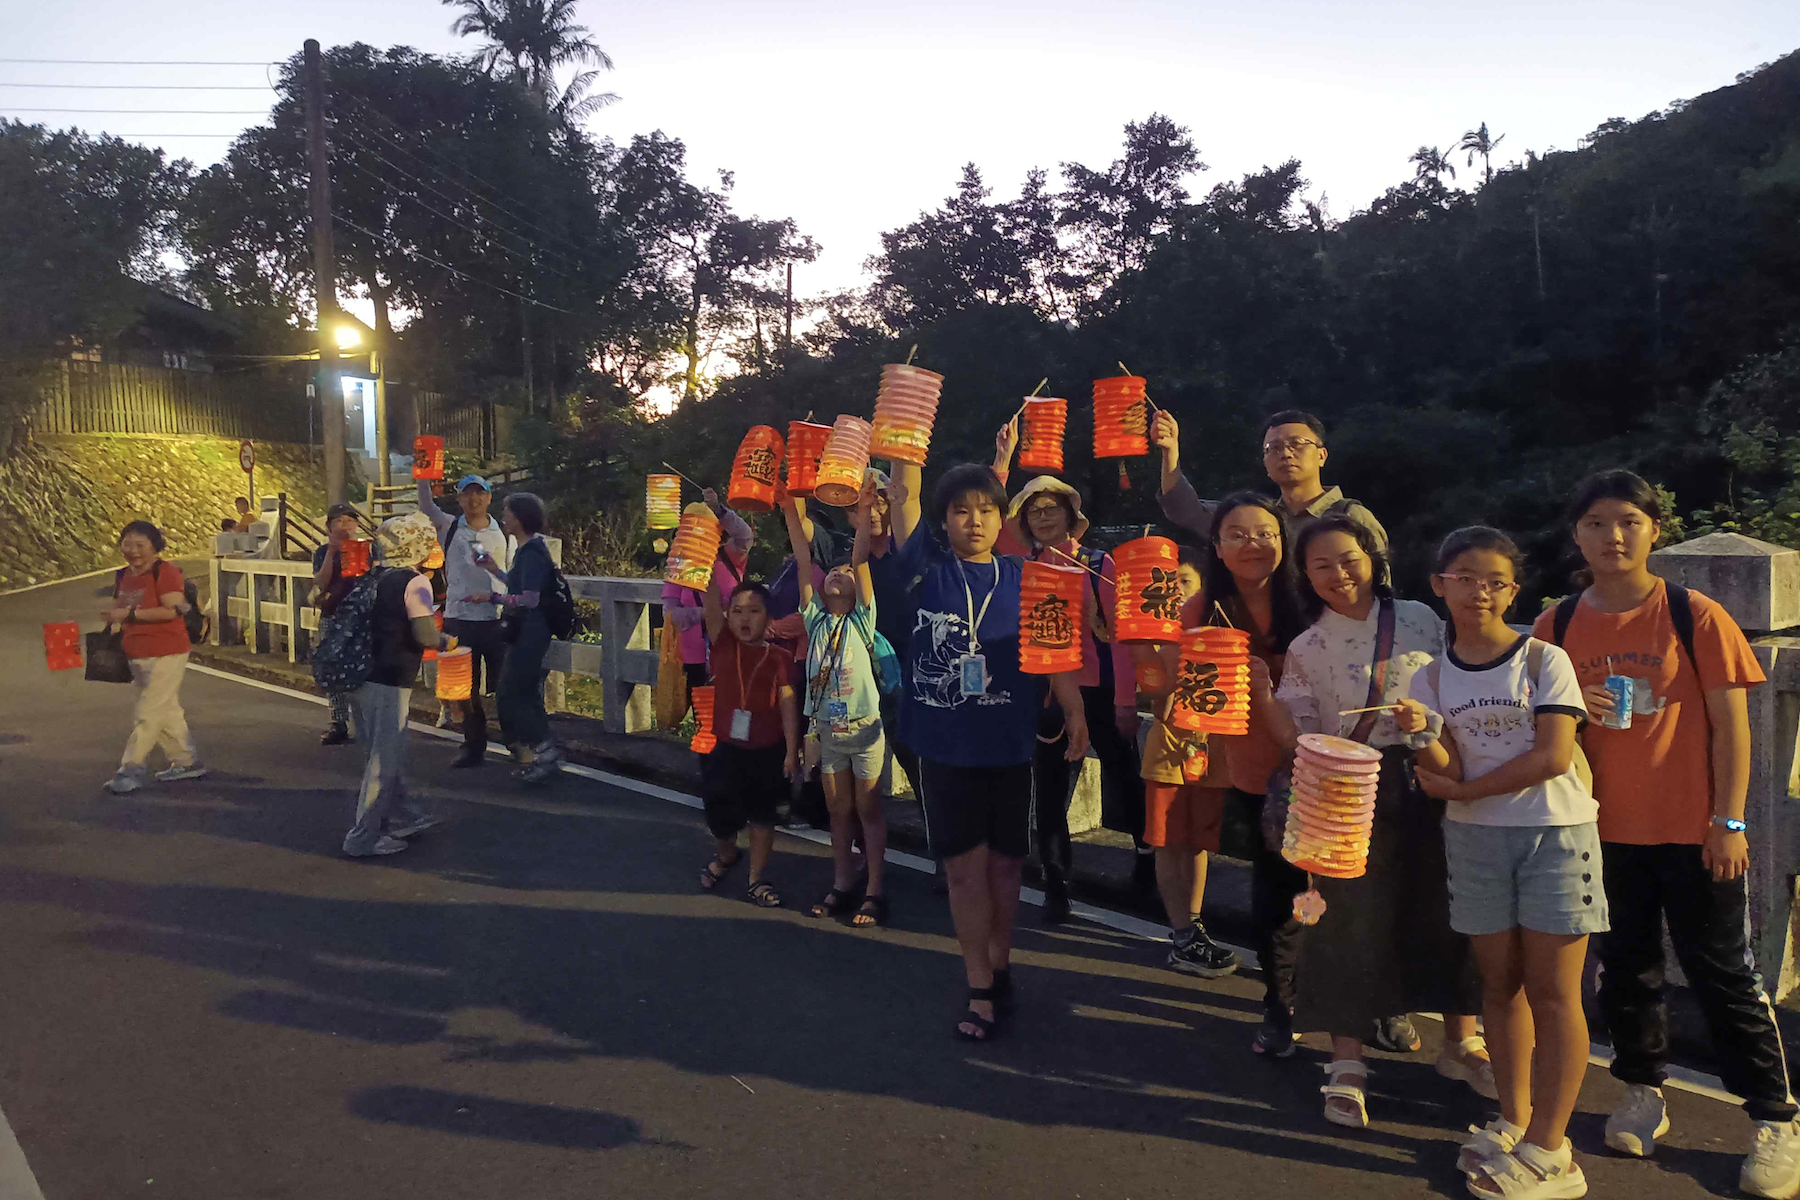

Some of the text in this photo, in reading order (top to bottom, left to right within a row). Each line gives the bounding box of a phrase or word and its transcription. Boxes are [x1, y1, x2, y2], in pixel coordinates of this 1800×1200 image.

[1579, 651, 1664, 674] SUMMER
[1175, 658, 1230, 716] 福
[1449, 696, 1528, 717] food friends
